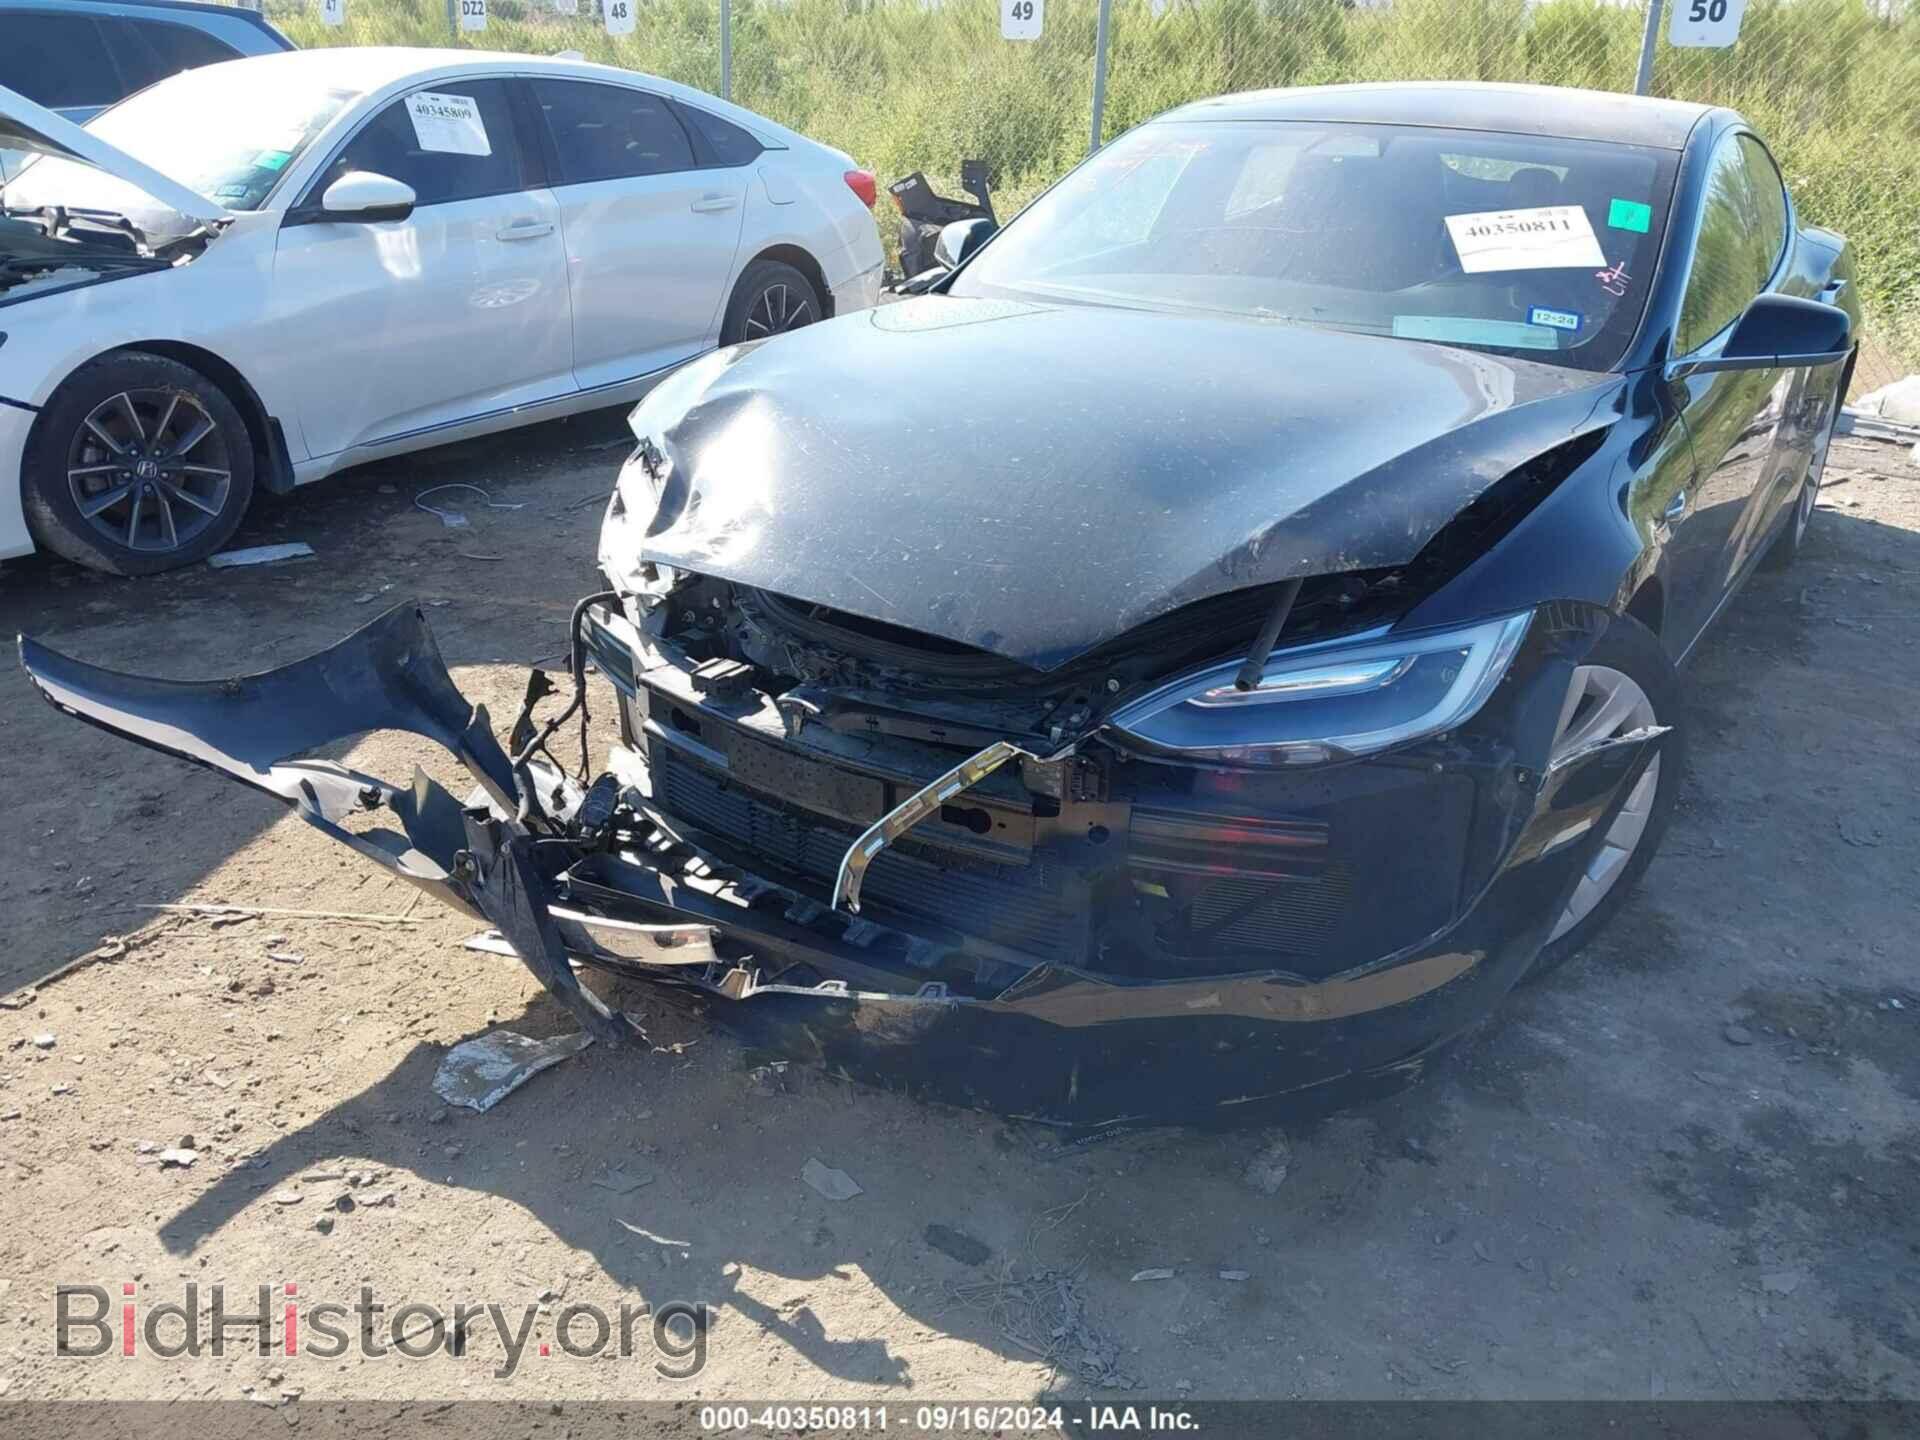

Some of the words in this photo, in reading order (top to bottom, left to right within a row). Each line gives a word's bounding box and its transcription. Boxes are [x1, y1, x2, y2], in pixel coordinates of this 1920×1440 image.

[462, 1, 484, 16] DZ2
[611, 3, 627, 19] 48
[1012, 1, 1034, 20] 49
[1688, 0, 1727, 22] 50
[415, 104, 472, 119] 40345809
[1465, 219, 1571, 238] 40350811
